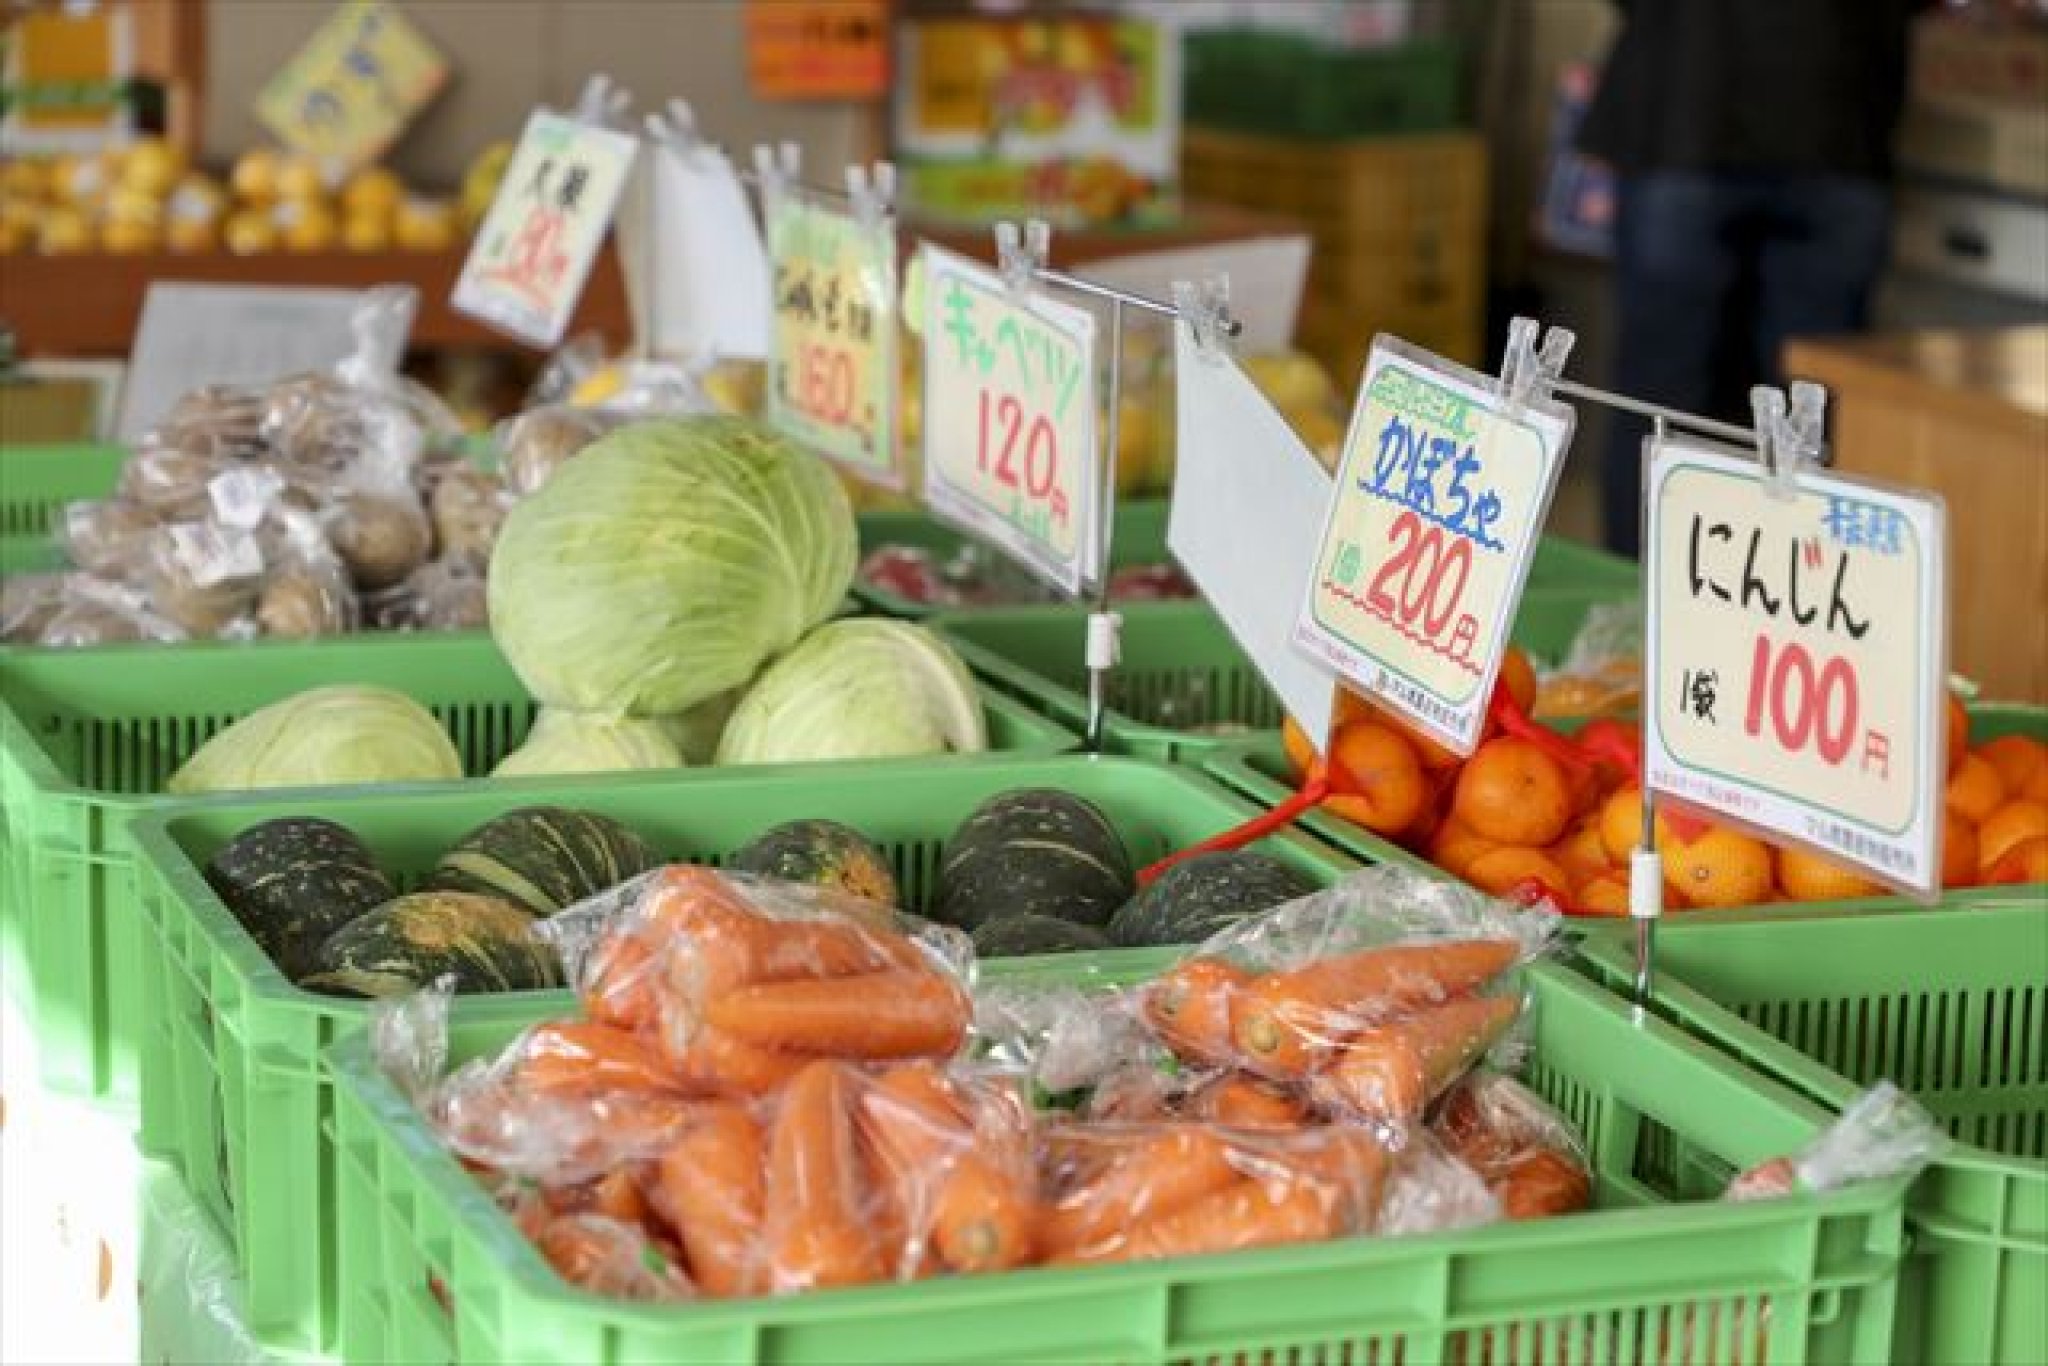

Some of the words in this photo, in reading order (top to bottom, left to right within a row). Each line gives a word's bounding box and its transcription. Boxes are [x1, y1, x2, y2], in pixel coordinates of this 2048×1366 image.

[944, 280, 1082, 420] キャベツ
[1372, 415, 1503, 542] かぼちゃ
[1688, 511, 1870, 641] にんじん
